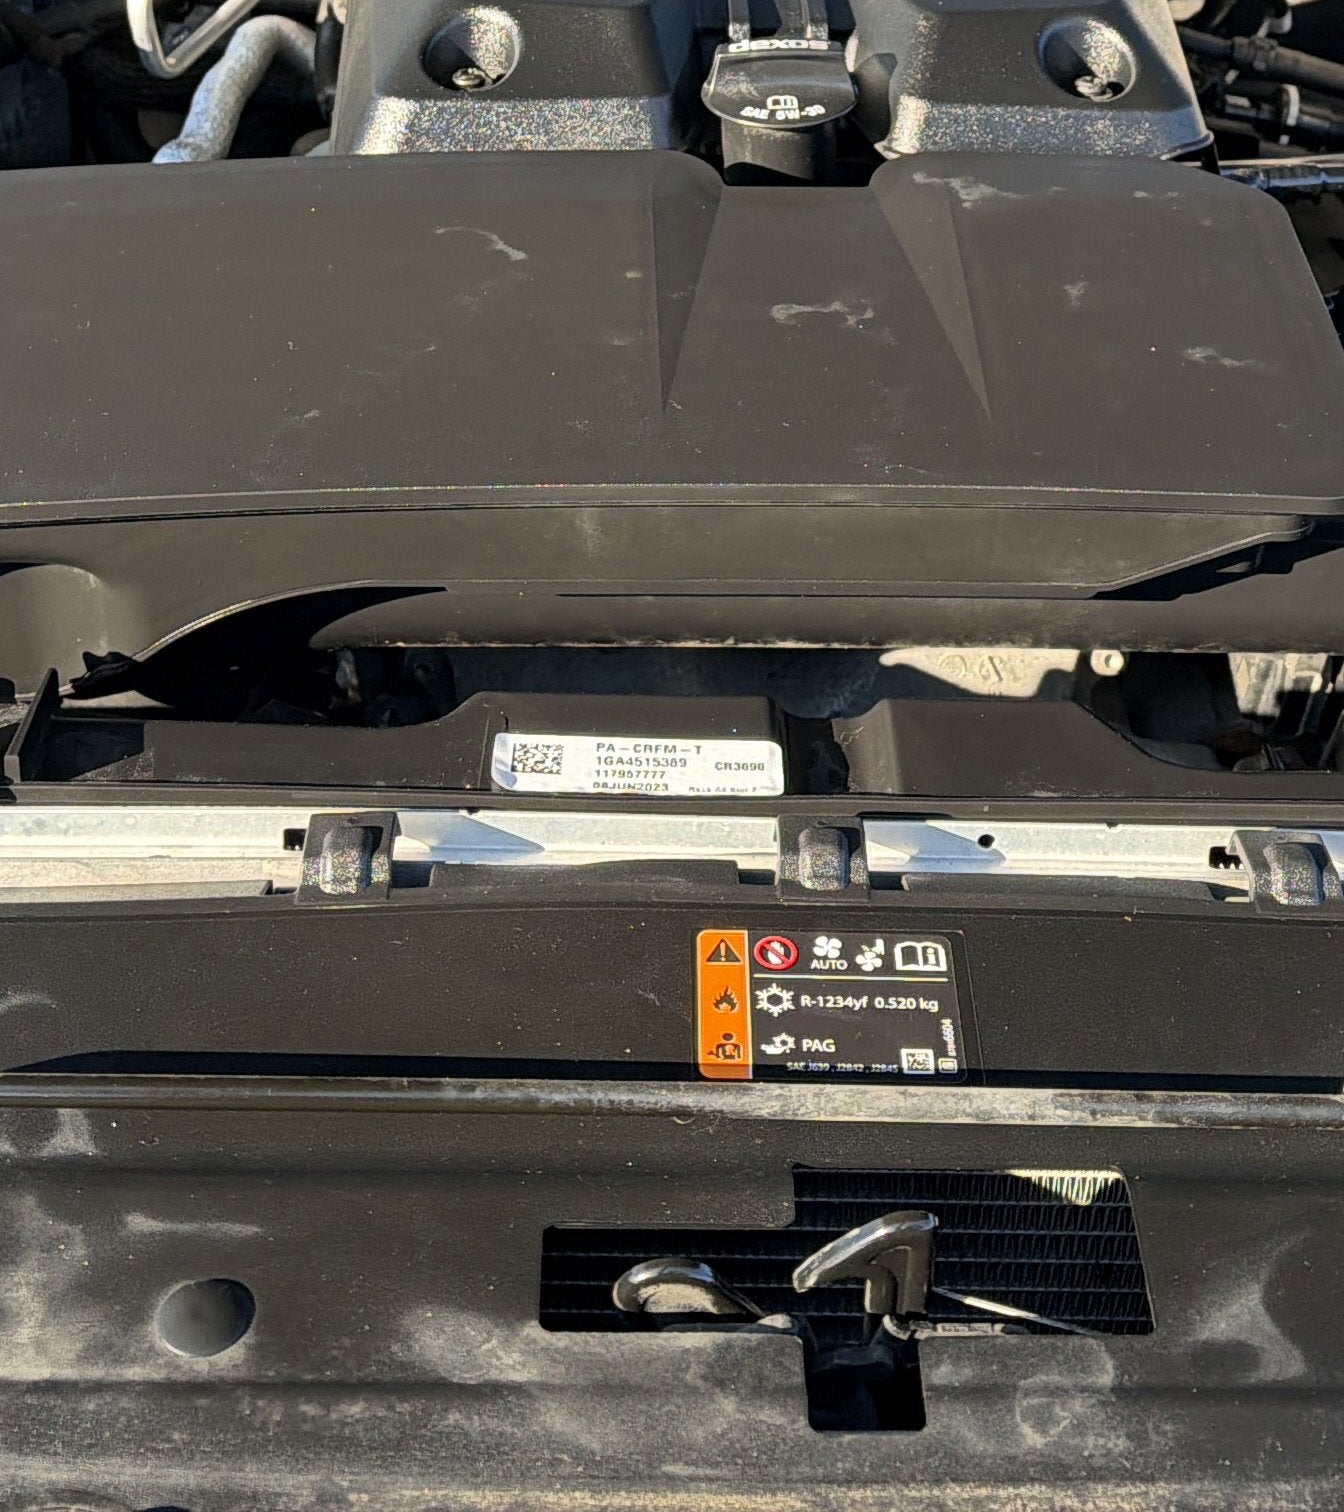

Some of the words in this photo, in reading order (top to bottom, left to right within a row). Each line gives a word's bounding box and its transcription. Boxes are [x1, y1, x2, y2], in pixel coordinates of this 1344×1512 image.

[739, 106, 771, 120] SAE
[810, 959, 849, 971] AUTO
[800, 995, 869, 1010] R-1234yf
[874, 997, 916, 1010] 0.520
[919, 997, 939, 1013] kg
[802, 1038, 836, 1053] PAG
